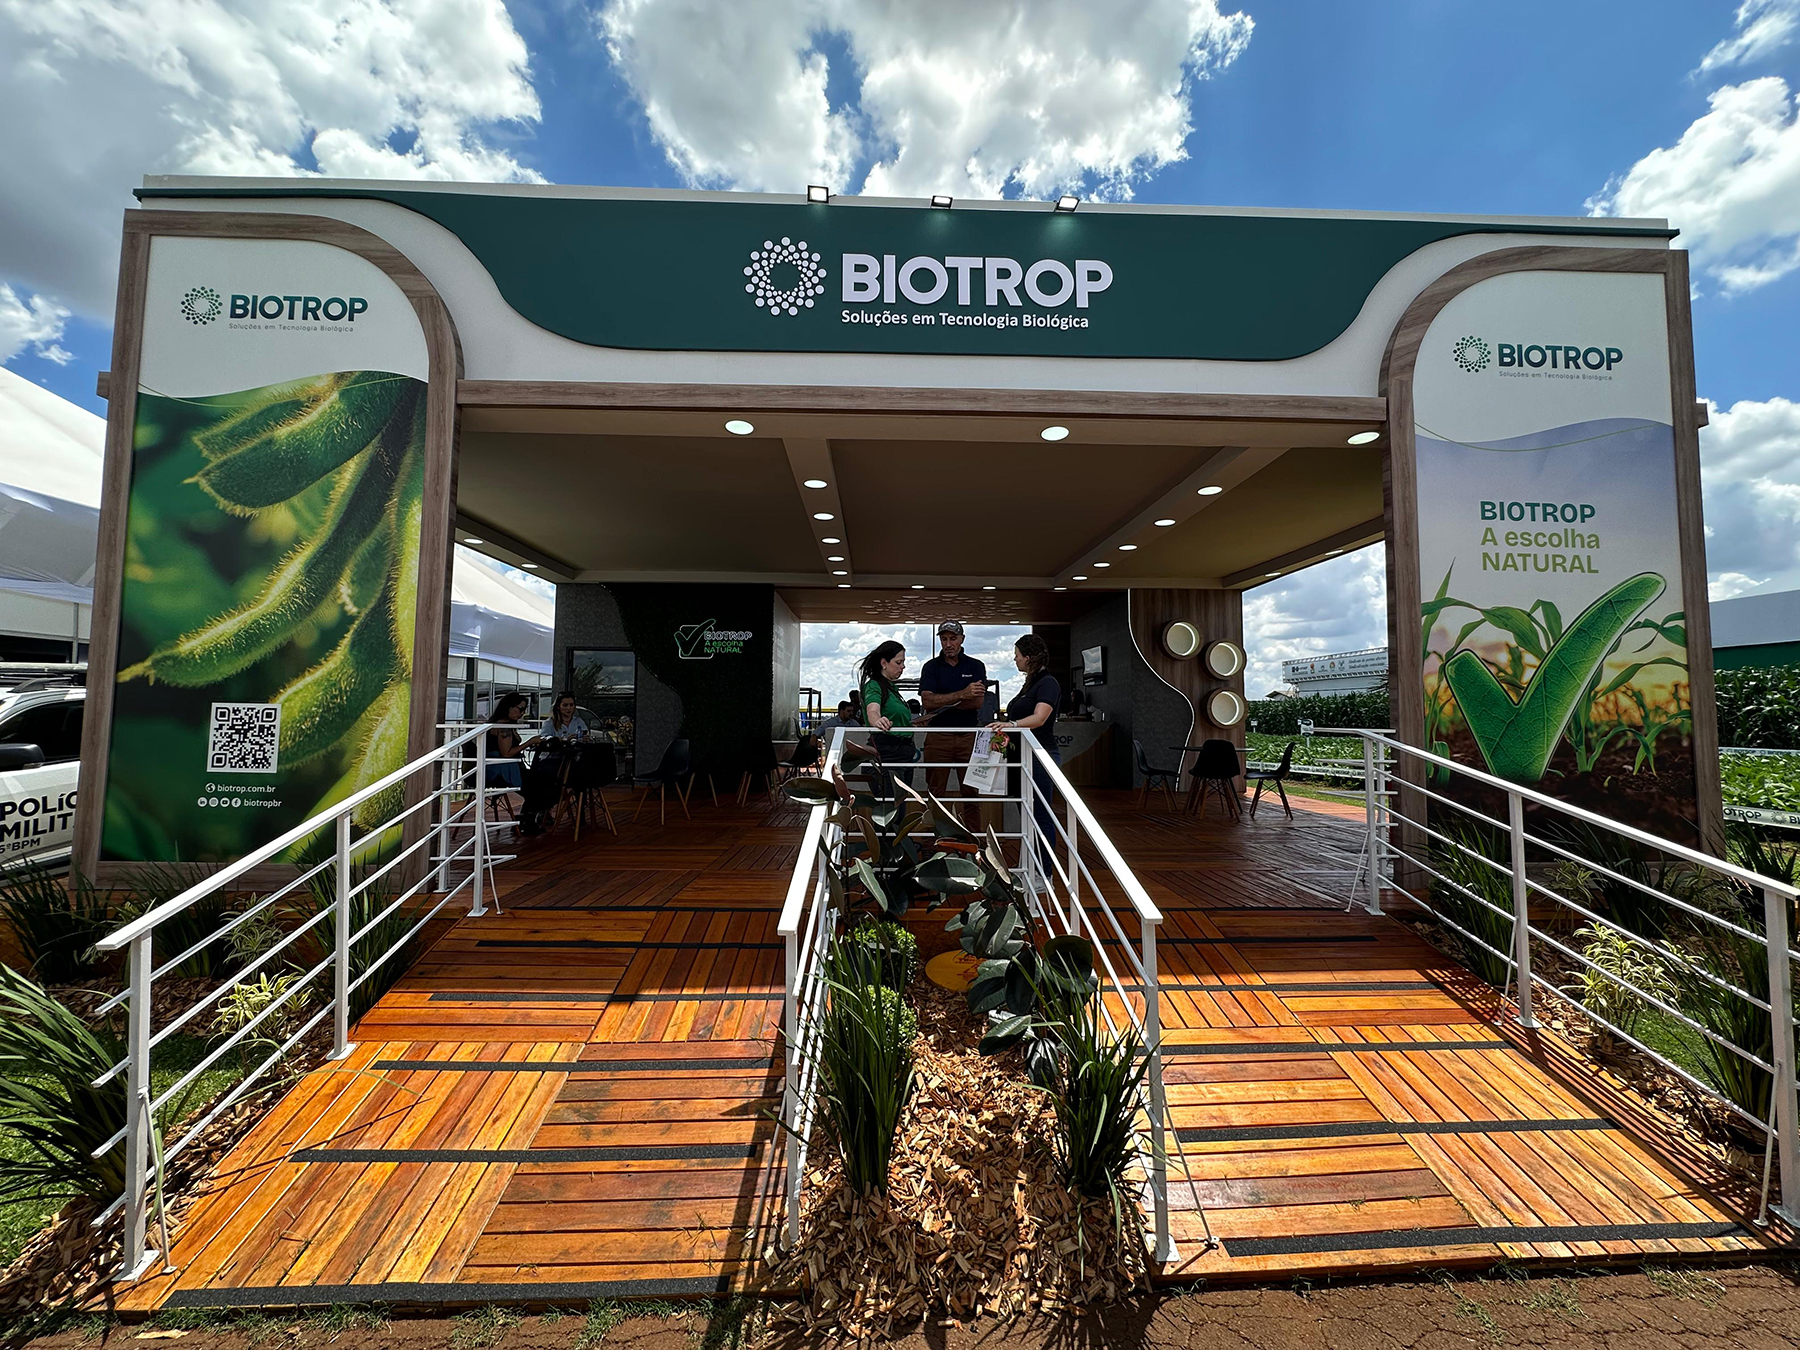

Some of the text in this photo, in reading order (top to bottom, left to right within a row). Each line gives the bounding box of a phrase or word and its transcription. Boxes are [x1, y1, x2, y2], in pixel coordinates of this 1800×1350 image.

[842, 253, 1114, 309] BIOTROP
[230, 294, 369, 322] BIOTROP
[229, 322, 261, 331] Soluções
[279, 323, 318, 332] Tecnologia
[320, 324, 354, 333] Biológica
[841, 309, 1089, 331] Soluções em Tecnologia Biológica
[1497, 343, 1623, 371] BIOTROP
[1499, 370, 1529, 379] Soluções
[1544, 372, 1580, 381] Tecnologia
[1582, 373, 1613, 382] Biológica
[1480, 500, 1596, 523] BIOTROP
[1480, 527, 1600, 549] A escolha
[1482, 552, 1599, 574] NATURAL
[703, 630, 753, 641] BIOTROP
[712, 639, 744, 647] escolha
[703, 646, 743, 654] NATURAL
[217, 783, 276, 794] biotrop.com.br
[243, 798, 282, 809] biotropbr
[0, 812, 75, 842] MILIT
